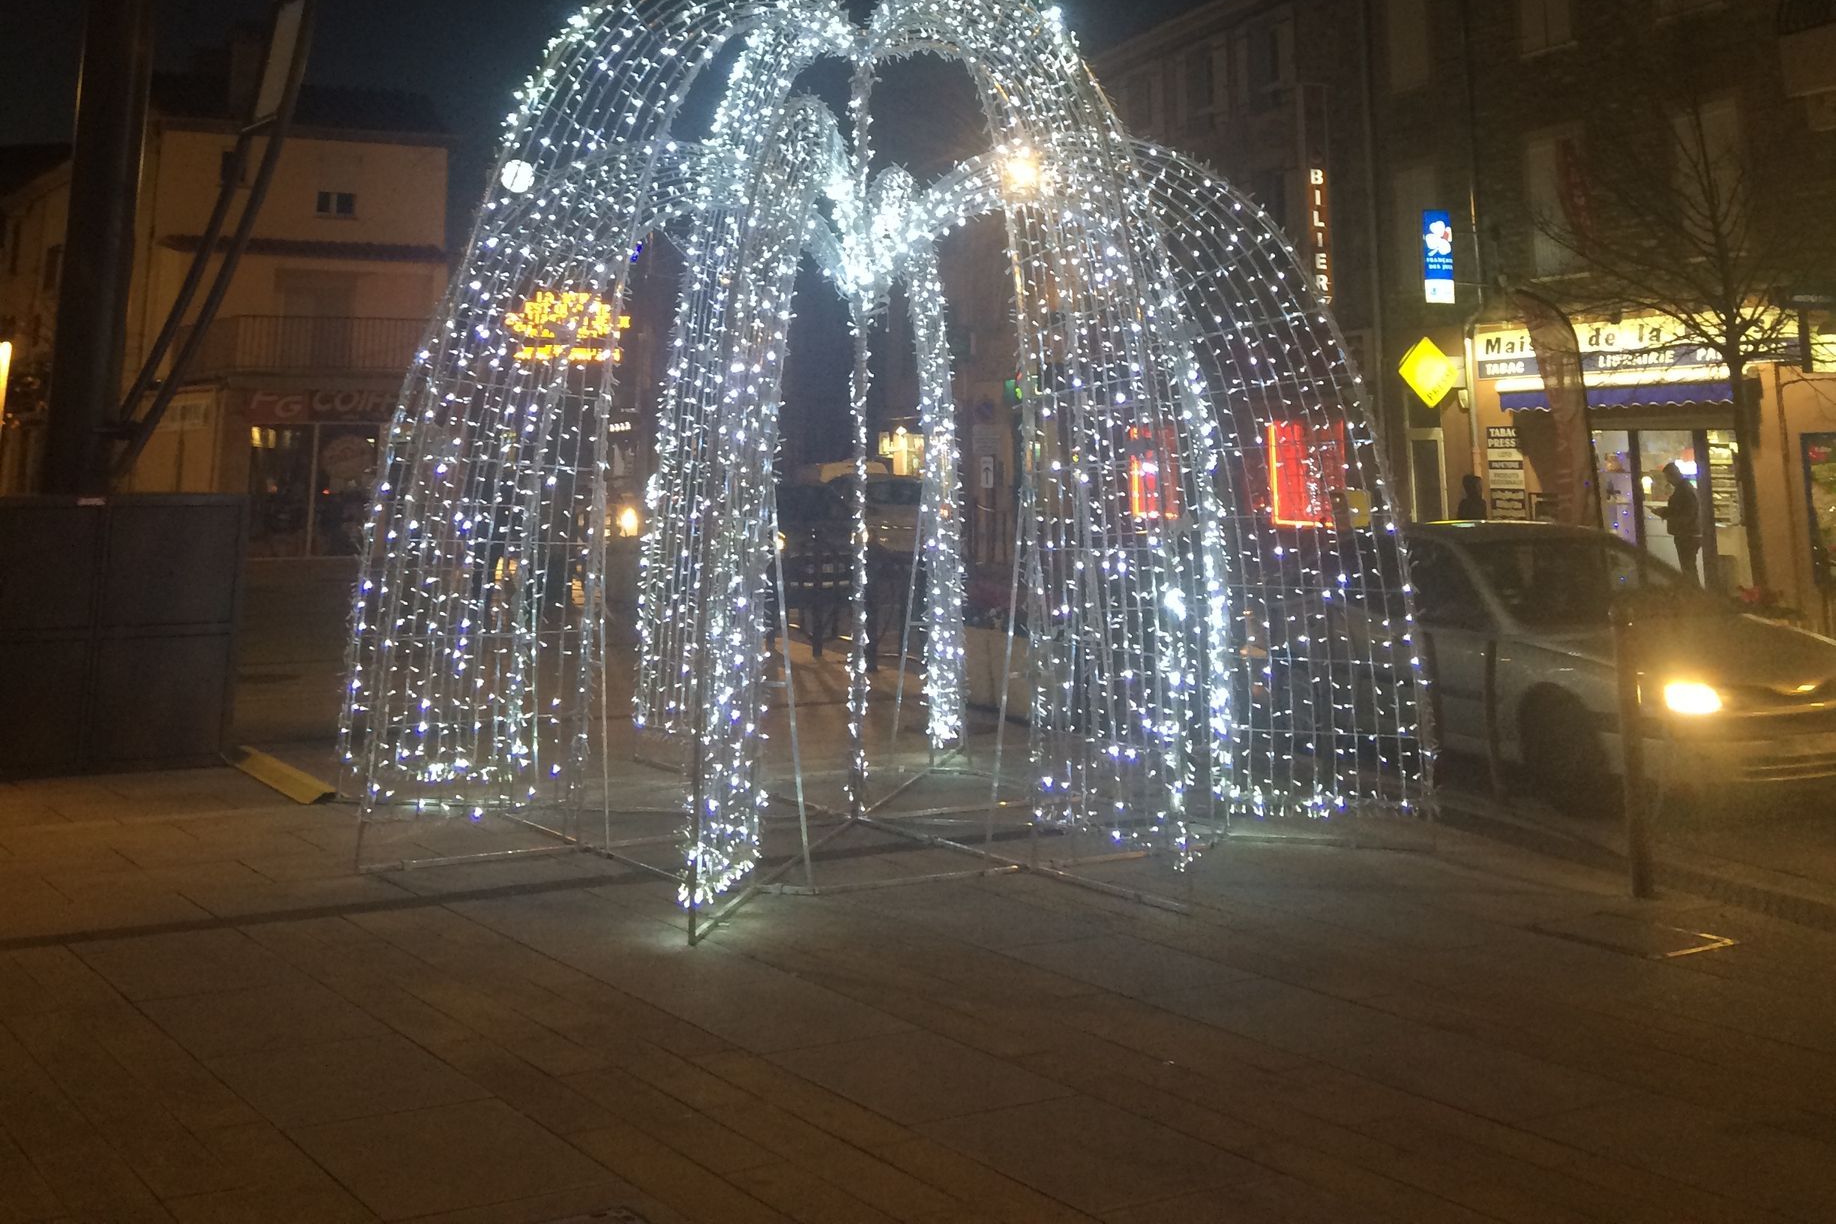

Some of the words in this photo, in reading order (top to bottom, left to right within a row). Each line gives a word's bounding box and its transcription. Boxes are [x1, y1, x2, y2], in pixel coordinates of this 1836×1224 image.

[1588, 327, 1616, 346] de
[1638, 323, 1662, 343] la
[1485, 361, 1525, 376] TABAC
[250, 391, 305, 418] FG
[1488, 428, 1517, 437] TABAC
[1487, 438, 1517, 448] PRESS
